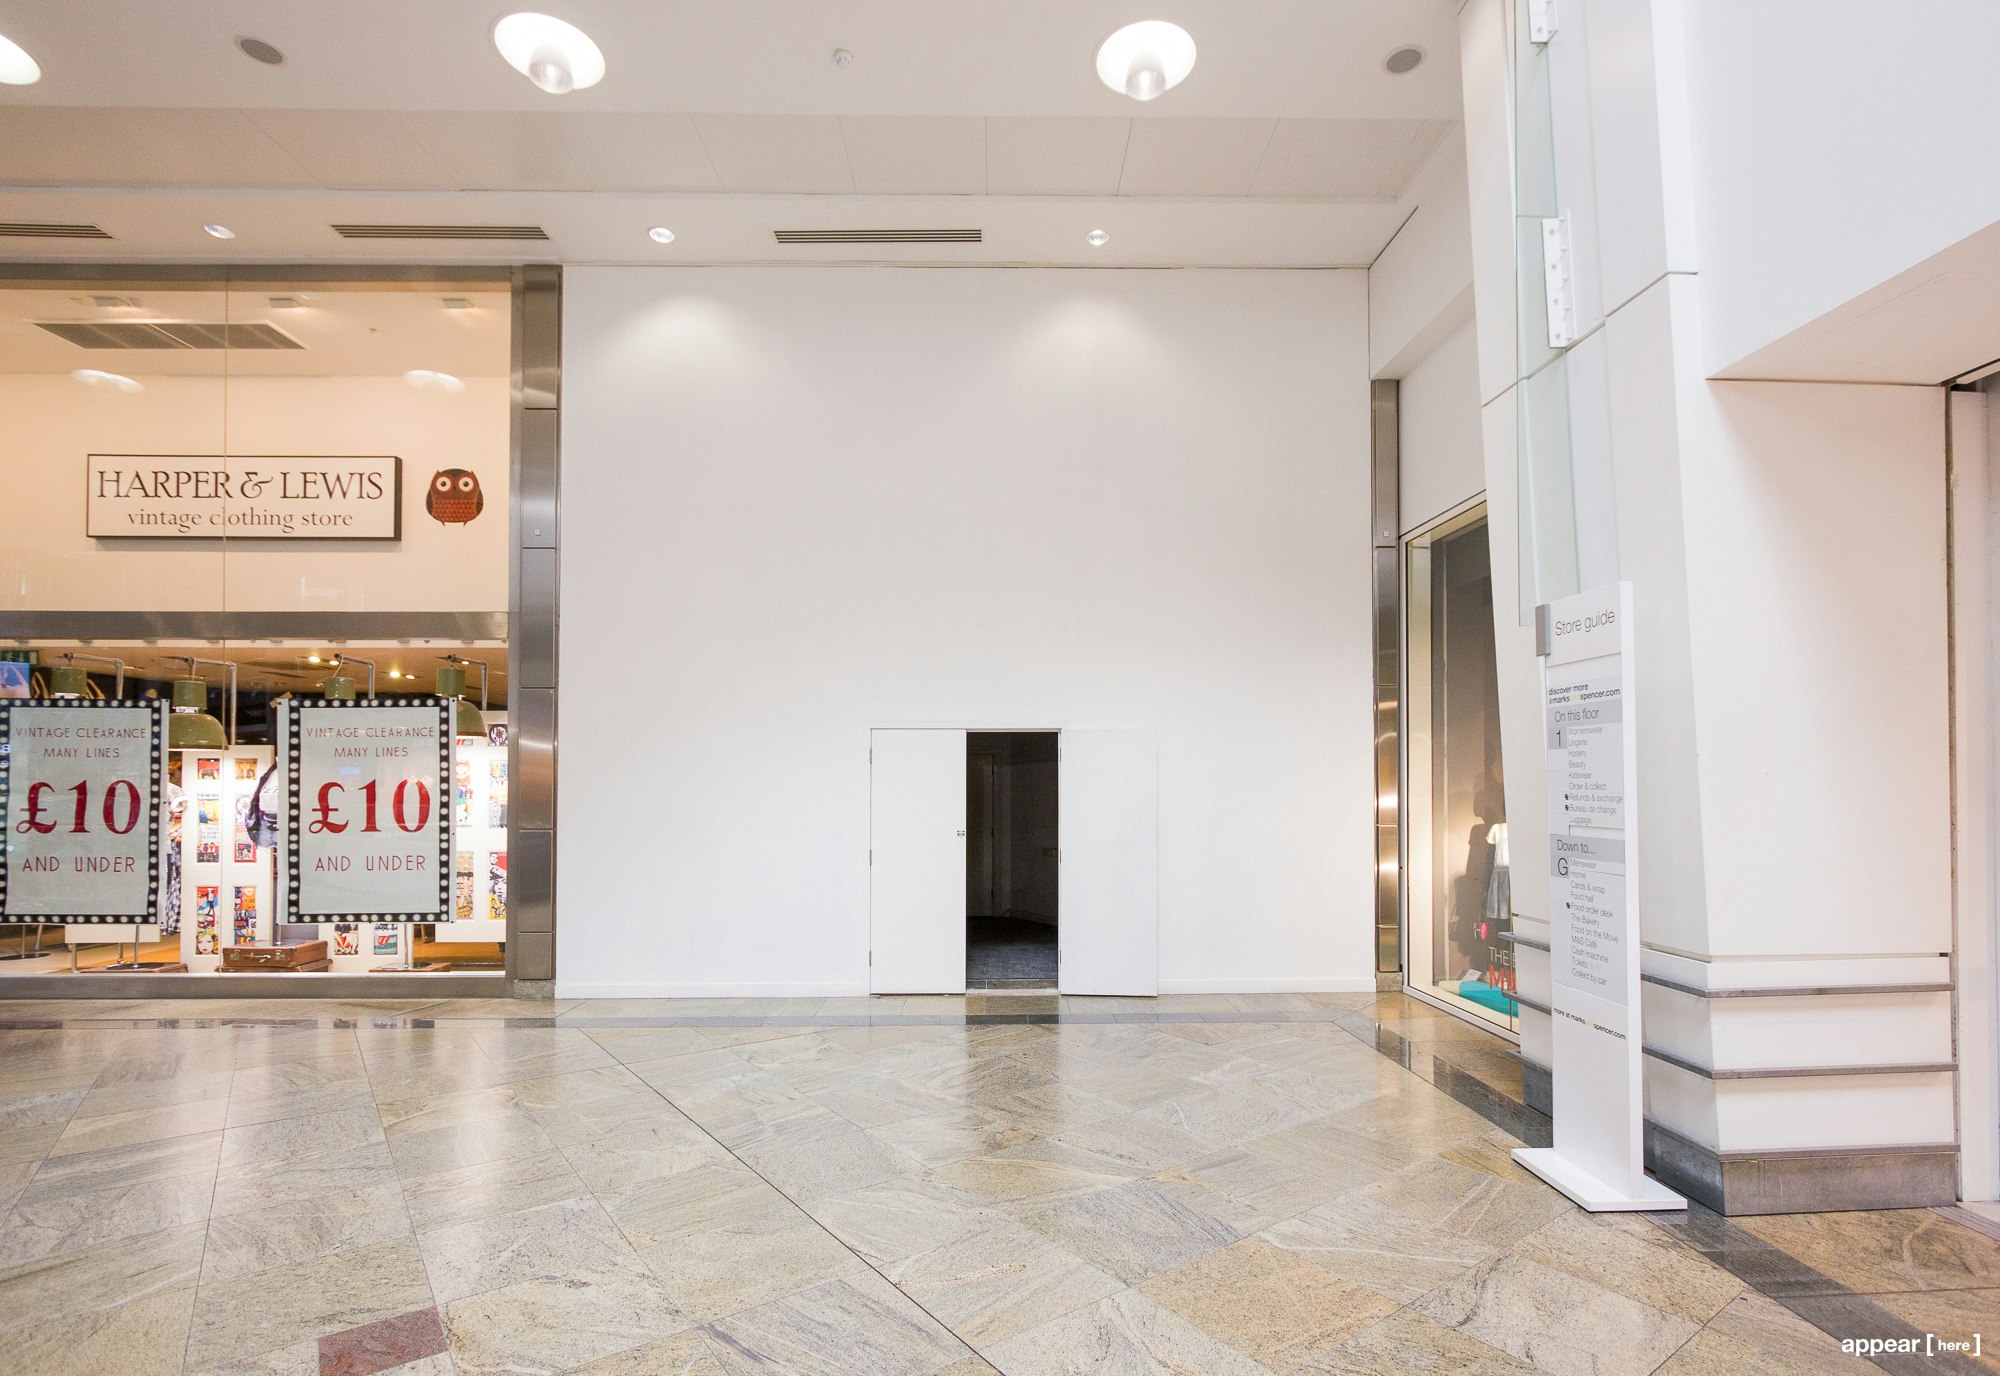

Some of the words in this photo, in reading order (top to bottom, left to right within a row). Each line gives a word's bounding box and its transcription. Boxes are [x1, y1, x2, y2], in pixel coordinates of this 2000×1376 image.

[97, 470, 233, 499] HARPER
[240, 471, 274, 499] &
[280, 471, 383, 500] LEWIS
[128, 508, 202, 534] vintage
[209, 506, 295, 534] clothing
[301, 509, 353, 527] store
[1555, 619, 1582, 636] Store
[1584, 608, 1615, 633] guide
[1549, 686, 1572, 696] discover
[1573, 684, 1588, 692] more
[1554, 711, 1566, 723] On
[1567, 709, 1581, 721] this
[1582, 708, 1600, 720] floor
[16, 727, 70, 738] VINTAGE
[76, 727, 146, 739] CLEARANCE
[306, 727, 359, 738] VINTAGE
[365, 726, 435, 738] CLEARANCE
[1556, 729, 1561, 747] 1
[43, 747, 79, 758] MANY
[86, 747, 121, 758] LINES
[334, 747, 368, 758] MANY
[375, 747, 409, 758] LINES
[16, 779, 141, 835] £10
[308, 778, 431, 834] £10
[1557, 839, 1579, 852] Down
[22, 856, 60, 872] AND
[74, 856, 136, 873] UNDER
[315, 855, 351, 872] AND
[366, 855, 426, 872] UNDER
[1557, 857, 1568, 876] G
[1488, 946, 1510, 966] THE
